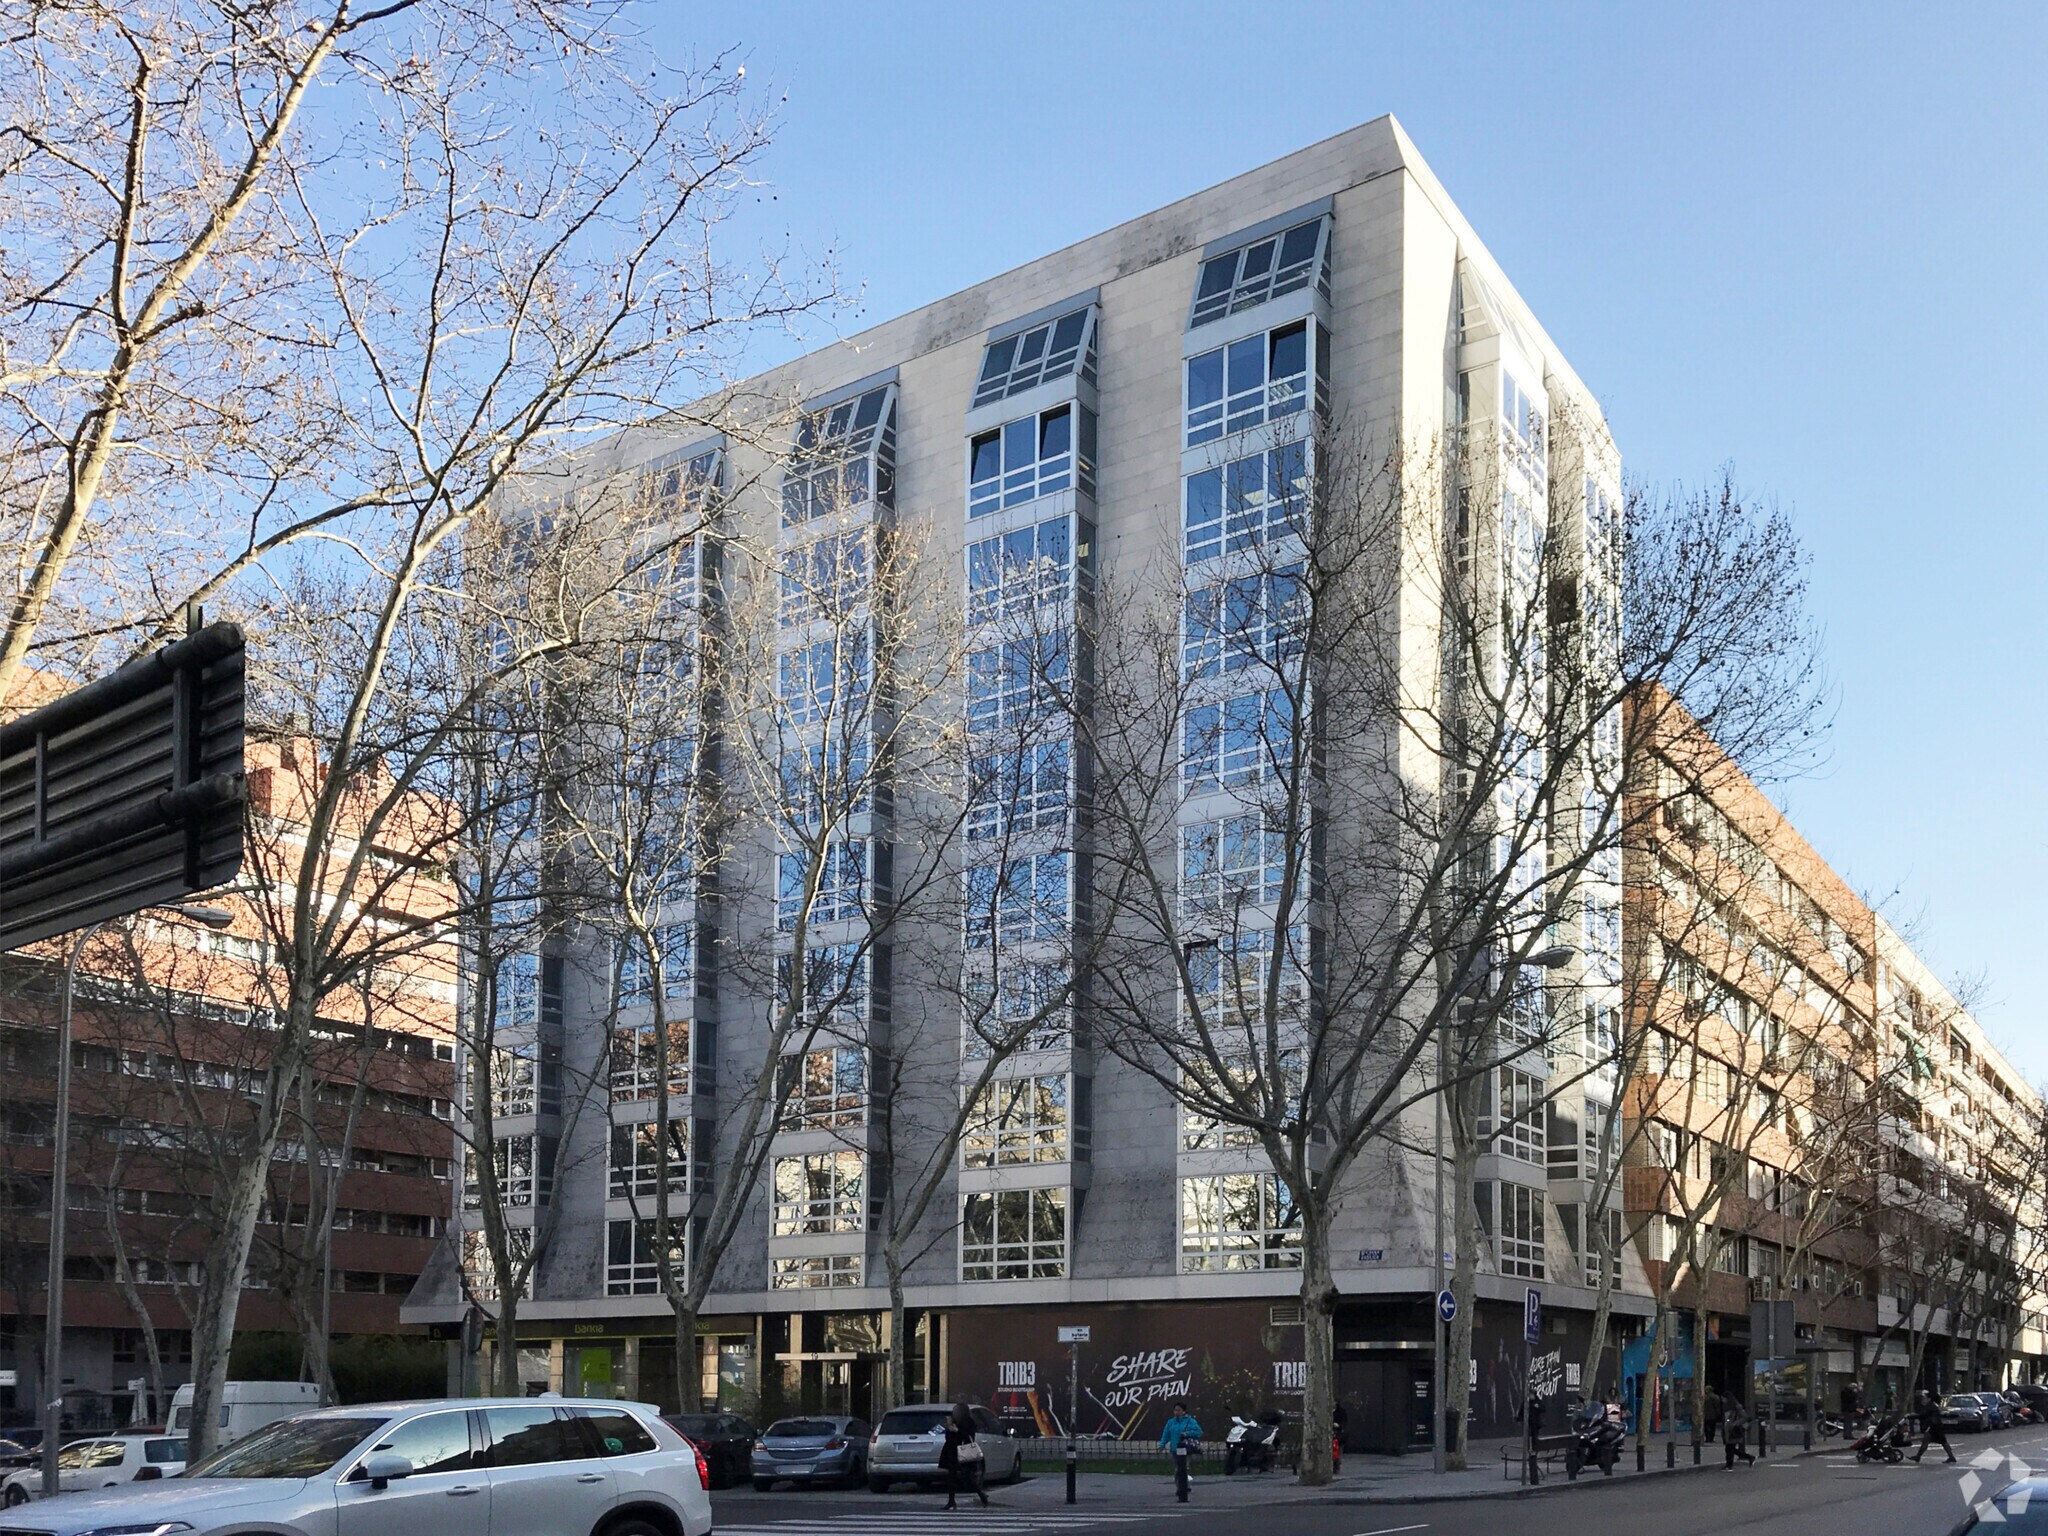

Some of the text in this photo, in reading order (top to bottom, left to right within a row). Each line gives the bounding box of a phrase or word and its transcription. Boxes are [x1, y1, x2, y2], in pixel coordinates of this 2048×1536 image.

[1529, 1292, 1539, 1325] P
[574, 1324, 604, 1334] Bankia
[998, 1361, 1036, 1386] TRIB3
[1106, 1347, 1193, 1383] SHARE
[1272, 1361, 1307, 1388] TRIB
[1105, 1387, 1142, 1407] OUR
